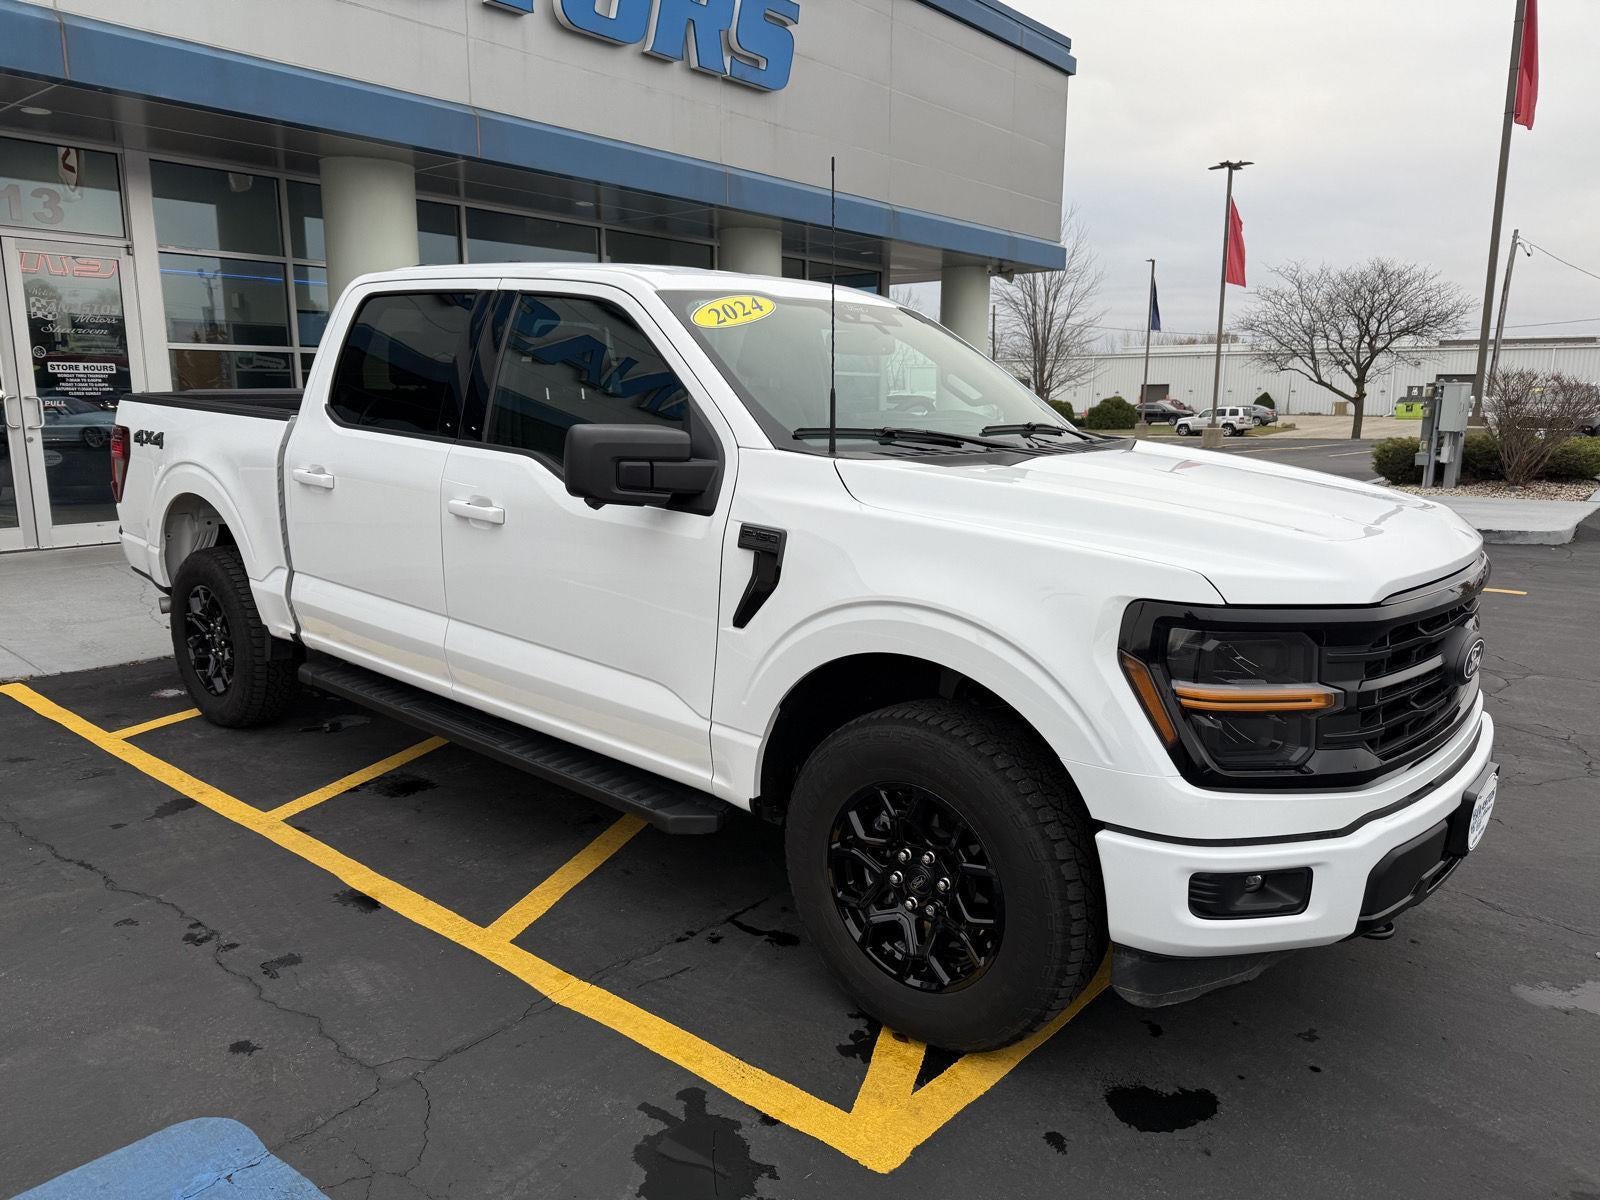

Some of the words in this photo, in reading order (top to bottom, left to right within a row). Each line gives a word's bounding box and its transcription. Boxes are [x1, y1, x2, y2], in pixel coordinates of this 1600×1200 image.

[708, 297, 764, 325] 2024
[75, 313, 119, 324] Motors
[40, 323, 109, 335] Showroom
[49, 363, 80, 371] STORE
[83, 364, 114, 372] HOURS
